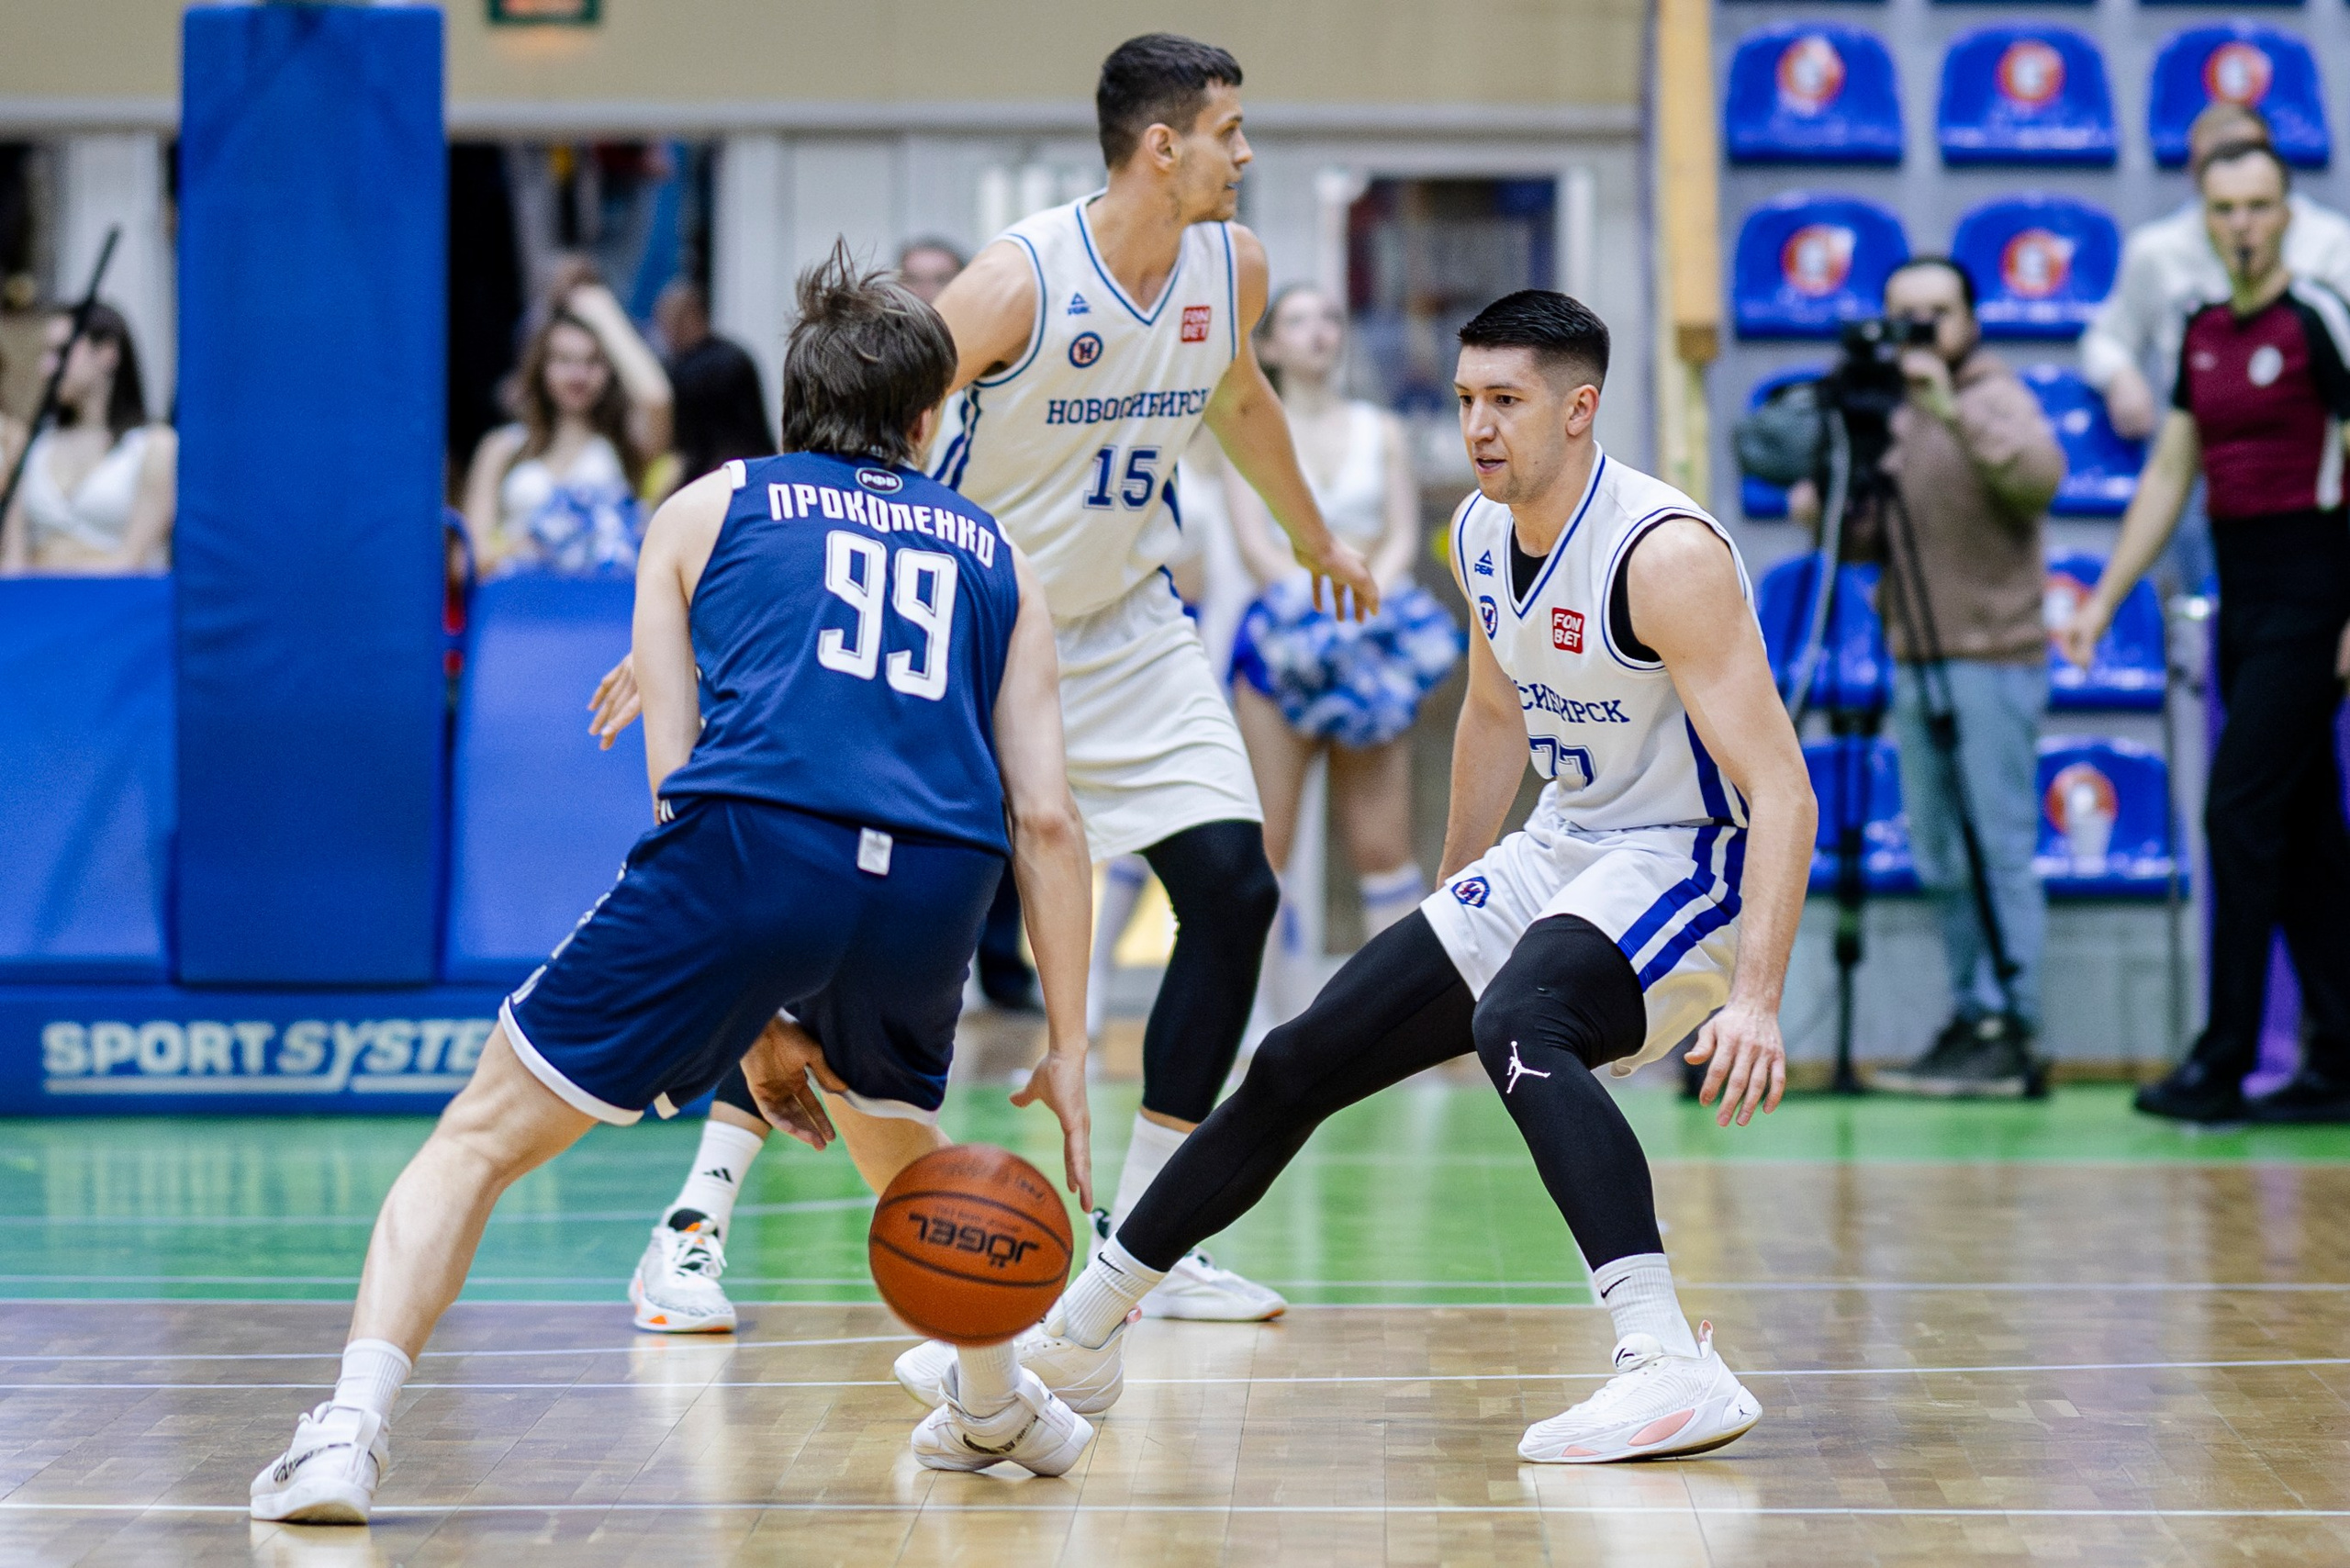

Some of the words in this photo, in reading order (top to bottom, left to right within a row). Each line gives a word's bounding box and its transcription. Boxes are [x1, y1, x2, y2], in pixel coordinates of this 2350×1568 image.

[1082, 444, 1162, 511] 15
[768, 482, 996, 568] ПРОКОПЕНКО
[817, 530, 958, 701] 99
[1553, 612, 1583, 633] FON
[1554, 628, 1581, 648] BET
[1513, 679, 1630, 723] СИБИРСК
[43, 1022, 274, 1075] SPORT
[276, 1019, 497, 1083] SYSTE
[908, 1211, 1039, 1269] JÖGEL
